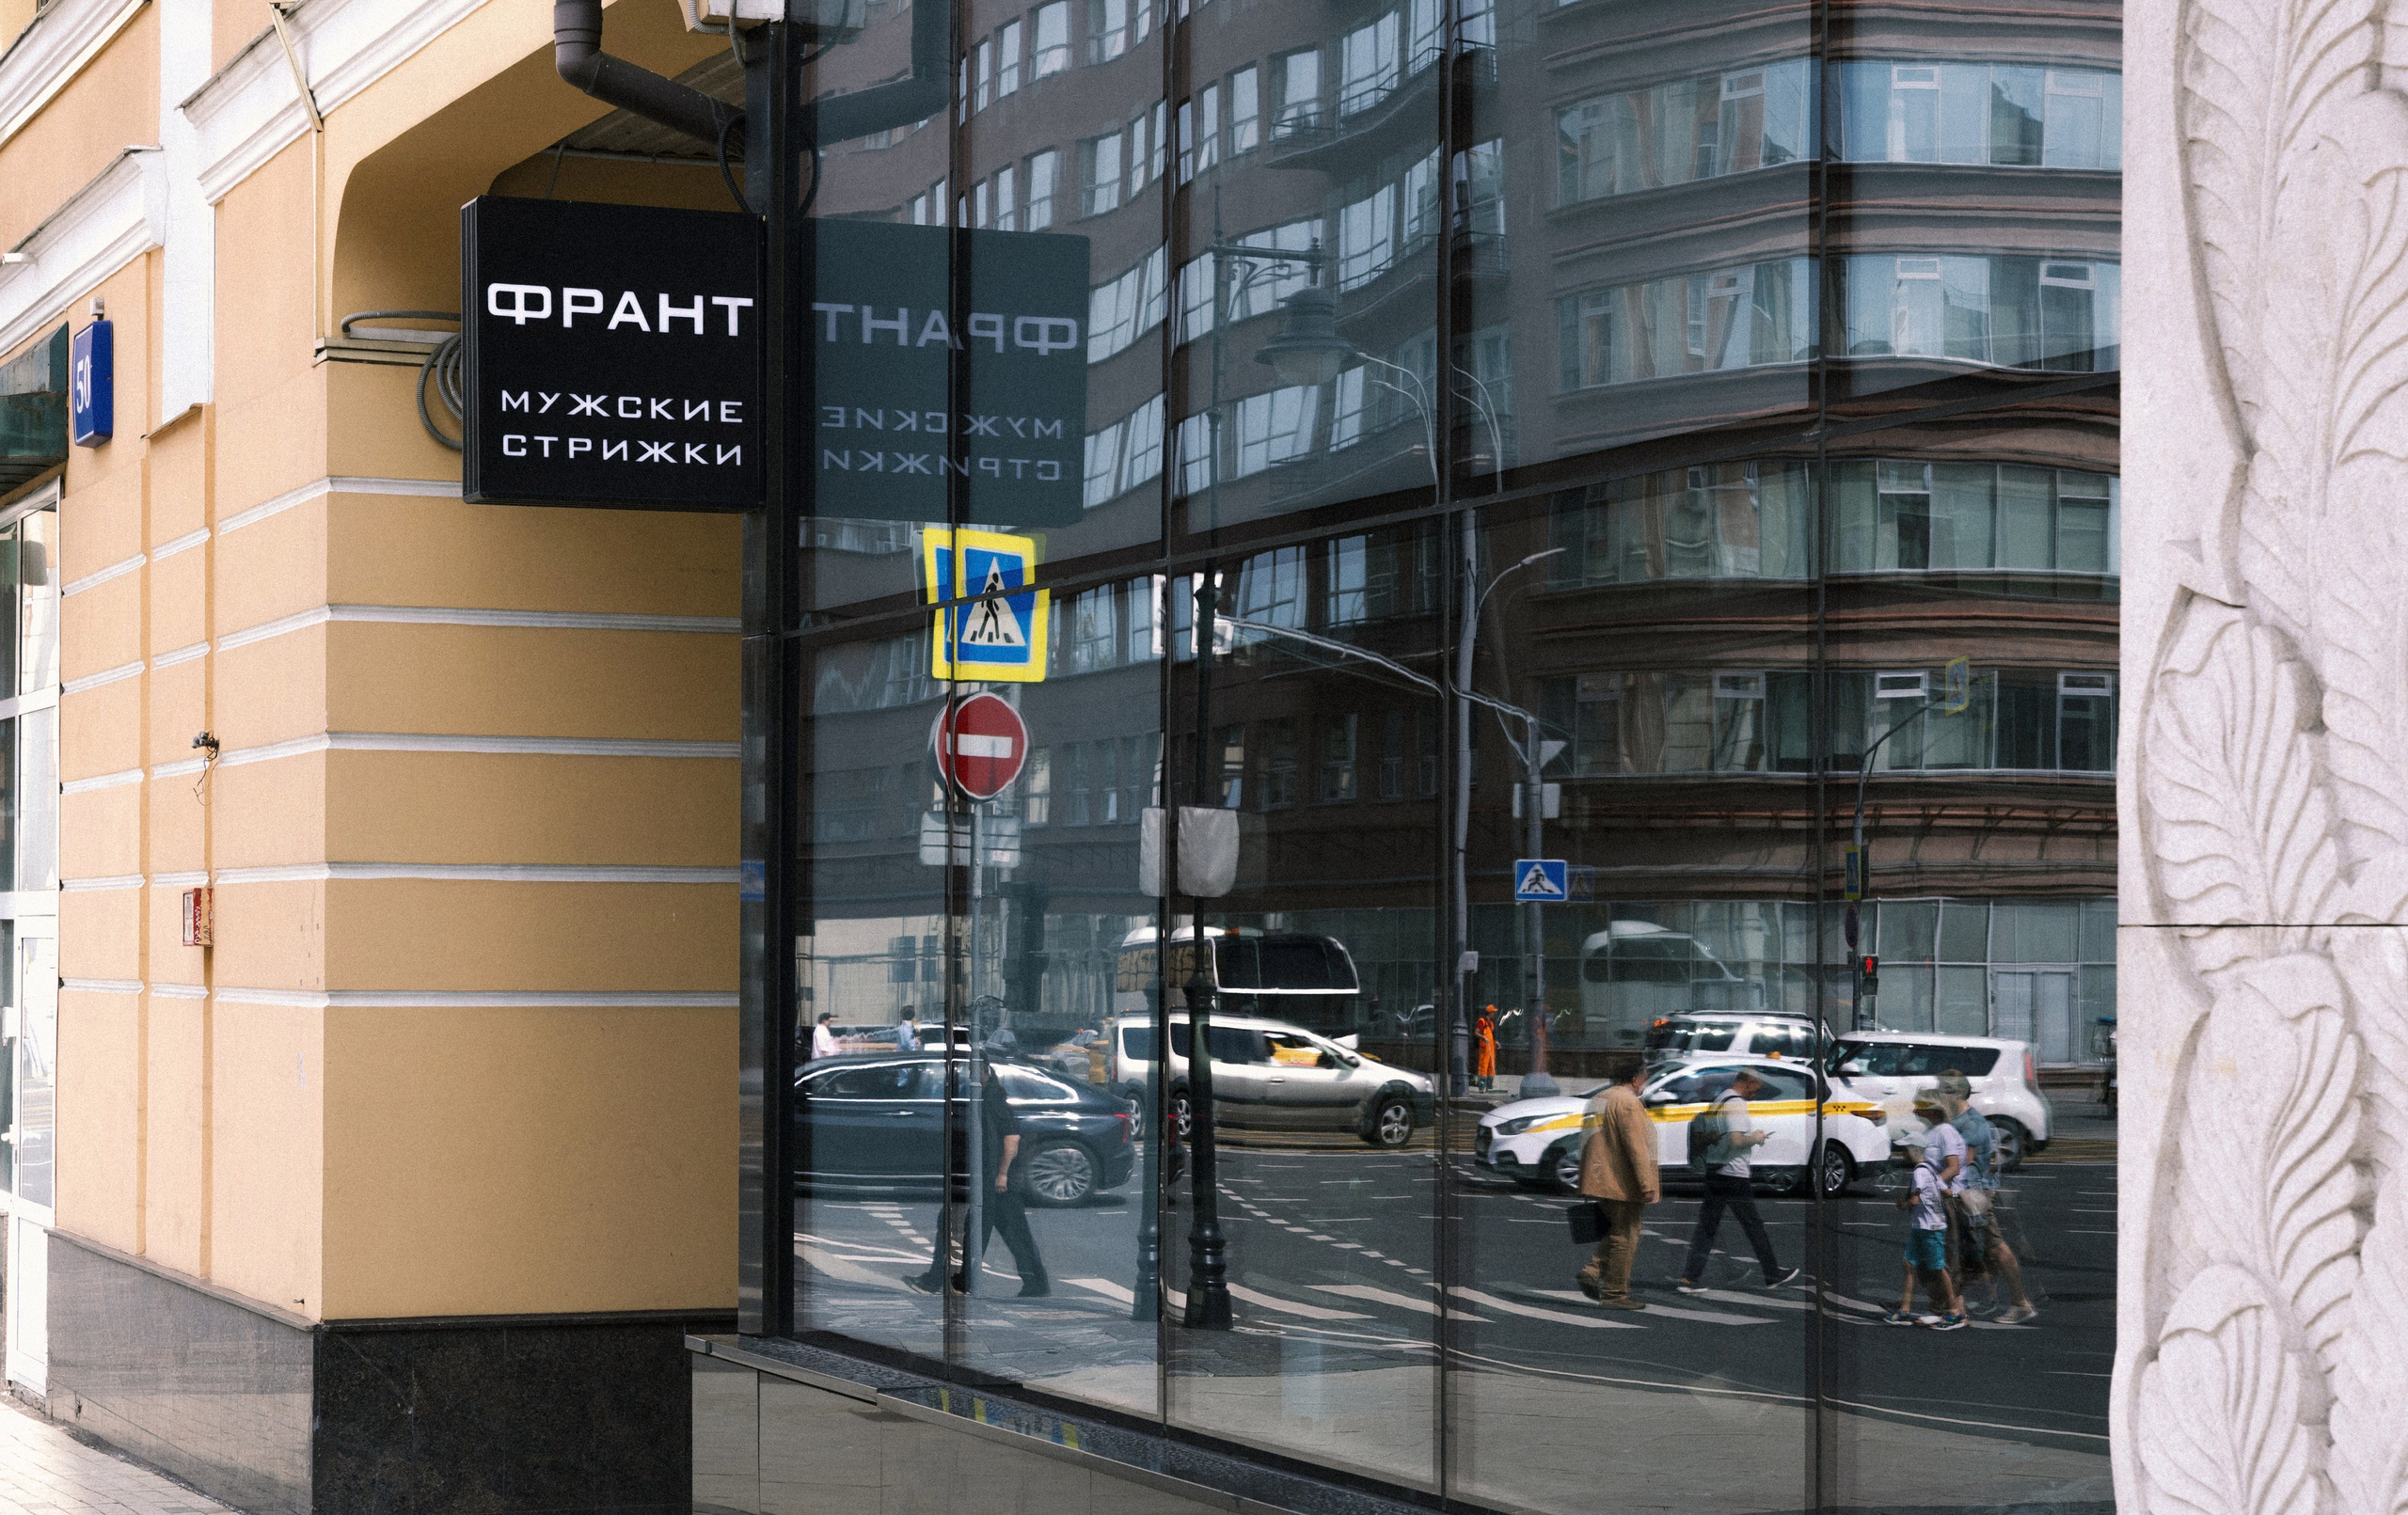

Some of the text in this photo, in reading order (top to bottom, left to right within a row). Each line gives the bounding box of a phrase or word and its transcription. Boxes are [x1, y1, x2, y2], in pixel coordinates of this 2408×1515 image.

[487, 282, 753, 337] ФРАНТ
[76, 355, 91, 414] 50
[501, 389, 743, 423] МУЖСКИЕ
[502, 434, 741, 466] СТРИЖКИ
